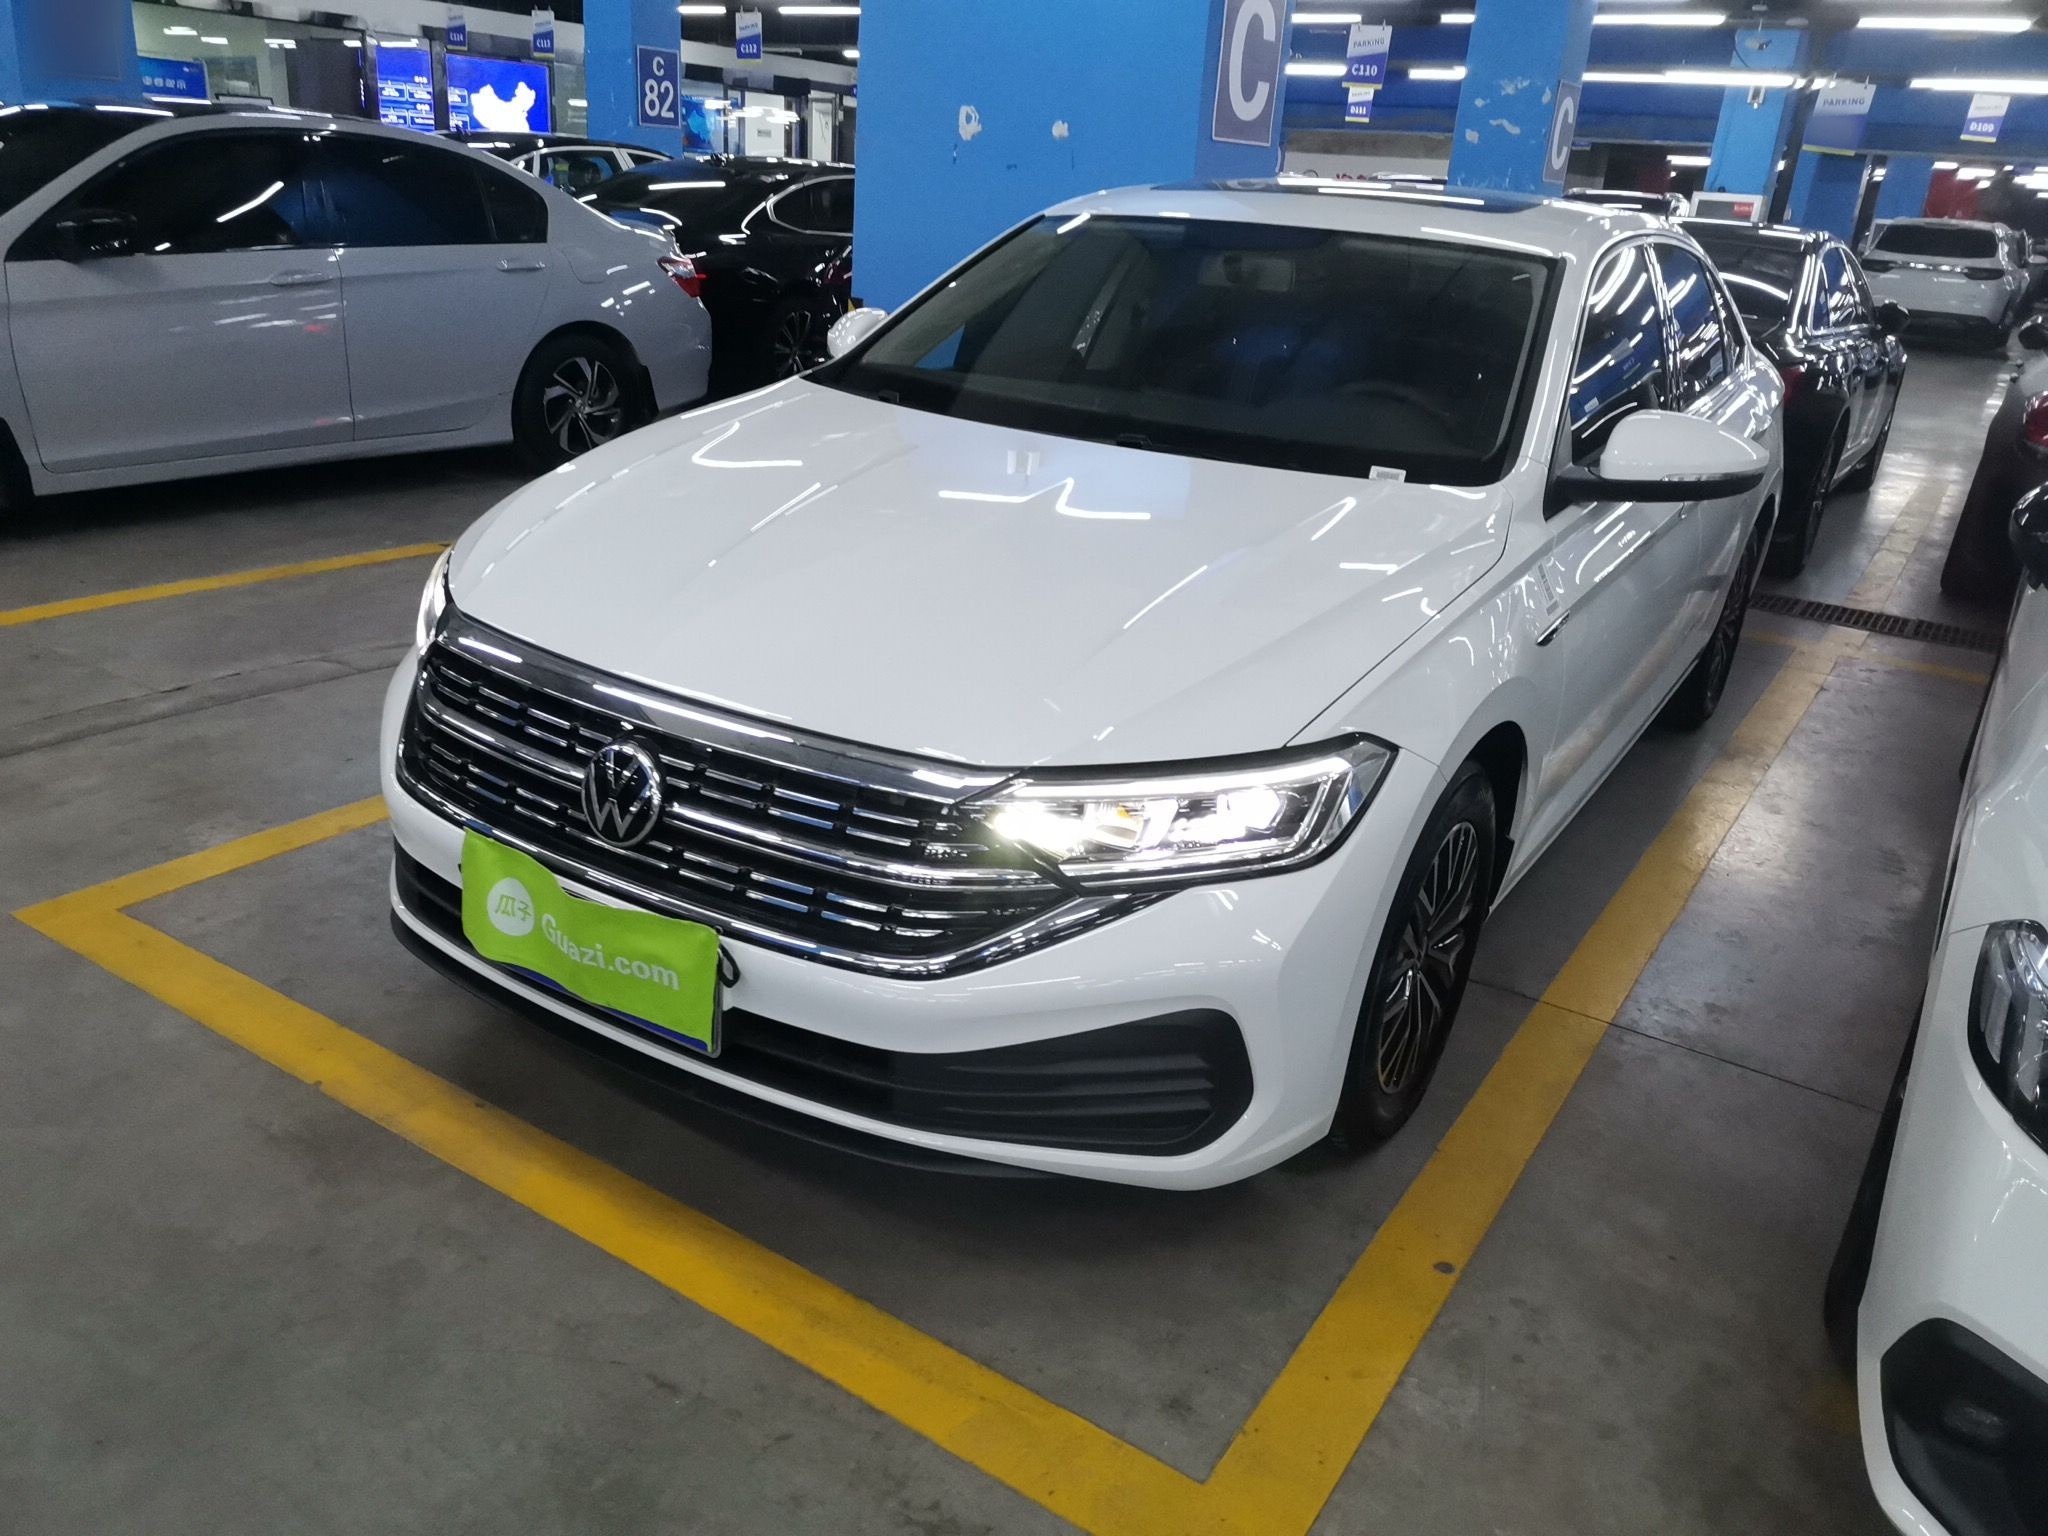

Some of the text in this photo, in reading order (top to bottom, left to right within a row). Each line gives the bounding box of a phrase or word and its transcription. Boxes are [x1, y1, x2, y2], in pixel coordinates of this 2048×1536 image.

[1353, 37, 1385, 49] PARKING
[652, 56, 666, 77] C
[1228, 0, 1276, 122] C
[1351, 63, 1379, 77] C110
[644, 78, 675, 119] 82
[1822, 97, 1866, 107] PARKING
[1551, 96, 1575, 170] C
[1968, 121, 1996, 134] D109
[494, 893, 532, 923] 瓜子
[540, 912, 680, 992] Guazi.com
